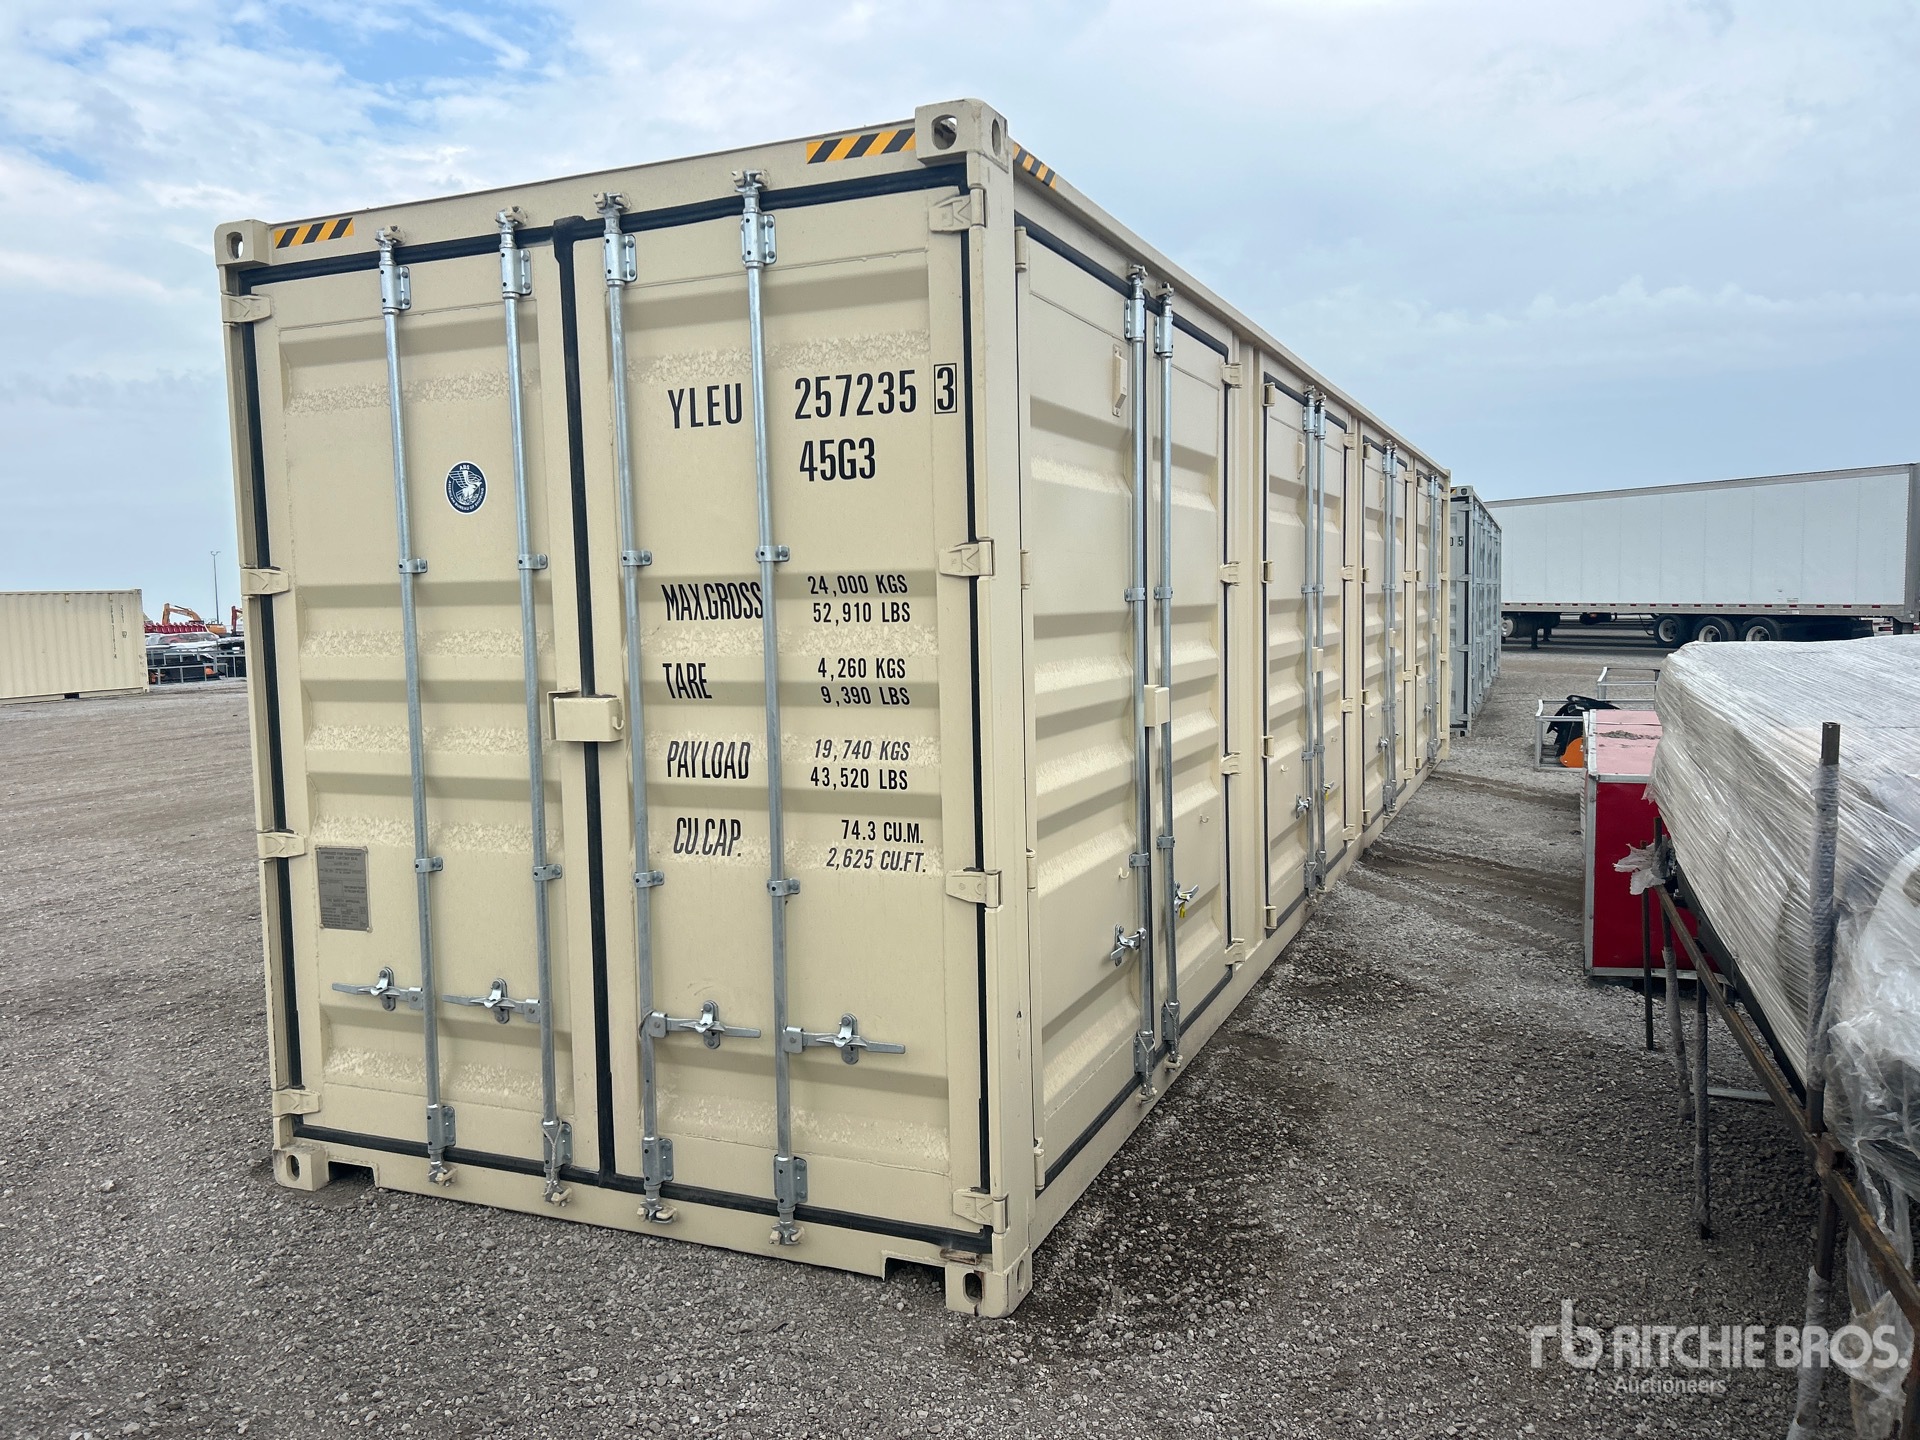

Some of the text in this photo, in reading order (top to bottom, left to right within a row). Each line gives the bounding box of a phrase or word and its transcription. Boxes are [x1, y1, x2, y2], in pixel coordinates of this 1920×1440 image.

[667, 366, 955, 429] YLEU 257235 3
[799, 437, 876, 482] 45G3
[807, 574, 908, 597] 24,000 KGS
[661, 581, 763, 621] MAX.GROSS
[812, 601, 911, 626] 52,910 LBS
[662, 662, 712, 699] TARE
[817, 657, 906, 681] 4,260 KGS
[820, 686, 910, 707] 9,390 LBS
[667, 740, 750, 780] PAYLOAD
[814, 738, 910, 762] 19,740 KGS
[810, 766, 908, 790] 43,520 LBS
[673, 817, 742, 858] CU.CAP.
[841, 819, 924, 844] 74.3 CU.M.
[826, 847, 926, 873] 2,625 CU.FT.
